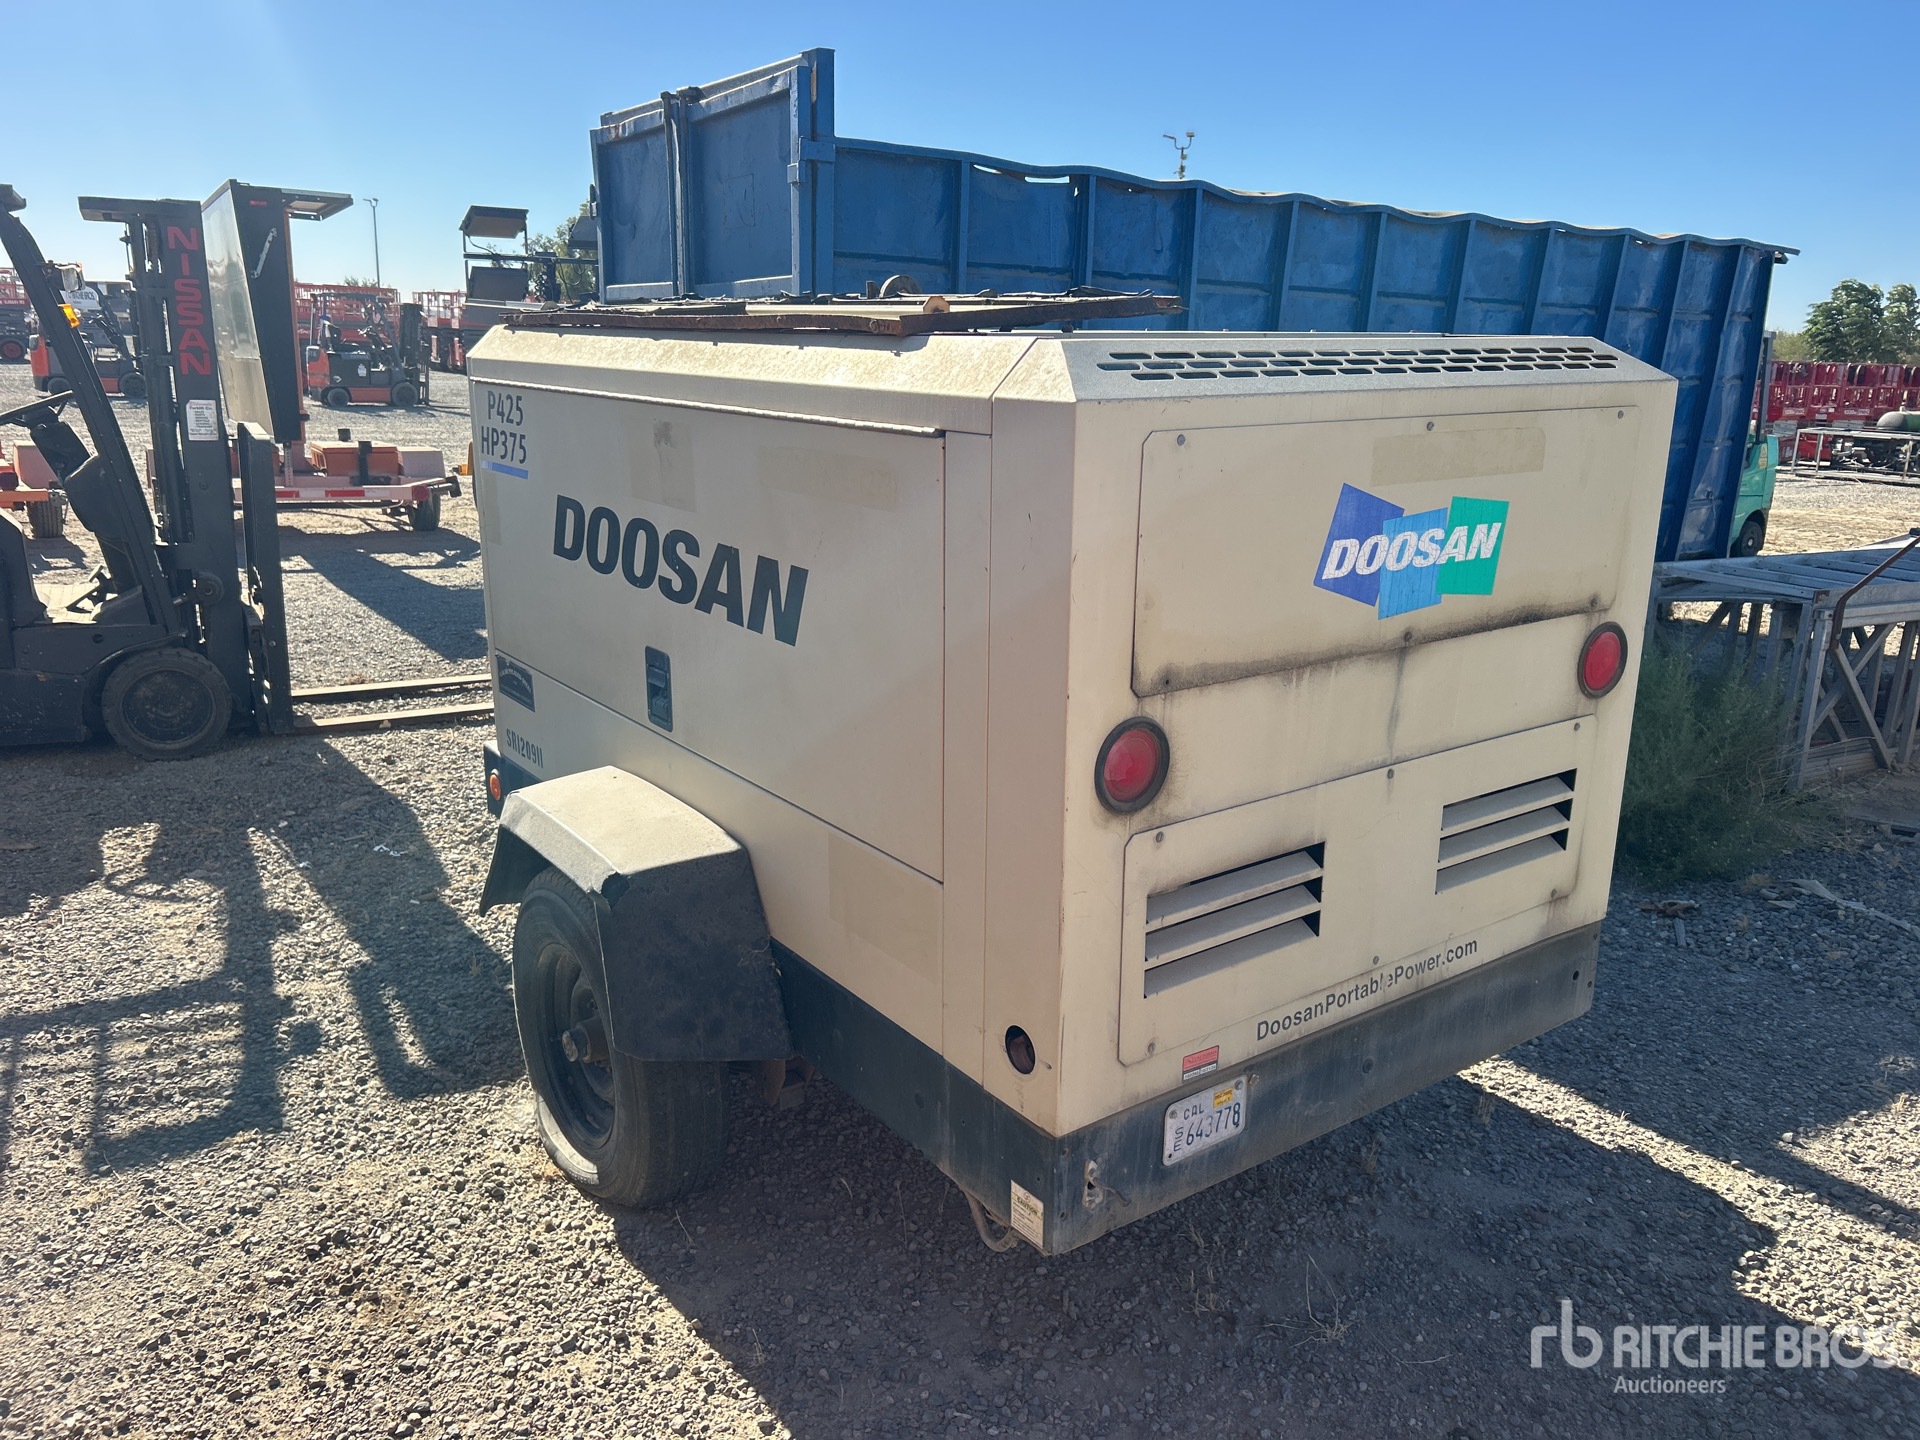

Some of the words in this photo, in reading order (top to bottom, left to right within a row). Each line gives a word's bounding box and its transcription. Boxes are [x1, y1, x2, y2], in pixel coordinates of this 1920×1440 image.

[167, 226, 211, 375] NISSAN
[487, 390, 523, 426] P425
[481, 426, 527, 464] HP375
[554, 494, 809, 647] DOOSAN
[1321, 522, 1502, 580] DOOSAN
[1257, 940, 1478, 1041] DoosanPortablePower.com
[1183, 1103, 1204, 1120] CAL
[1186, 1102, 1241, 1146] 643778
